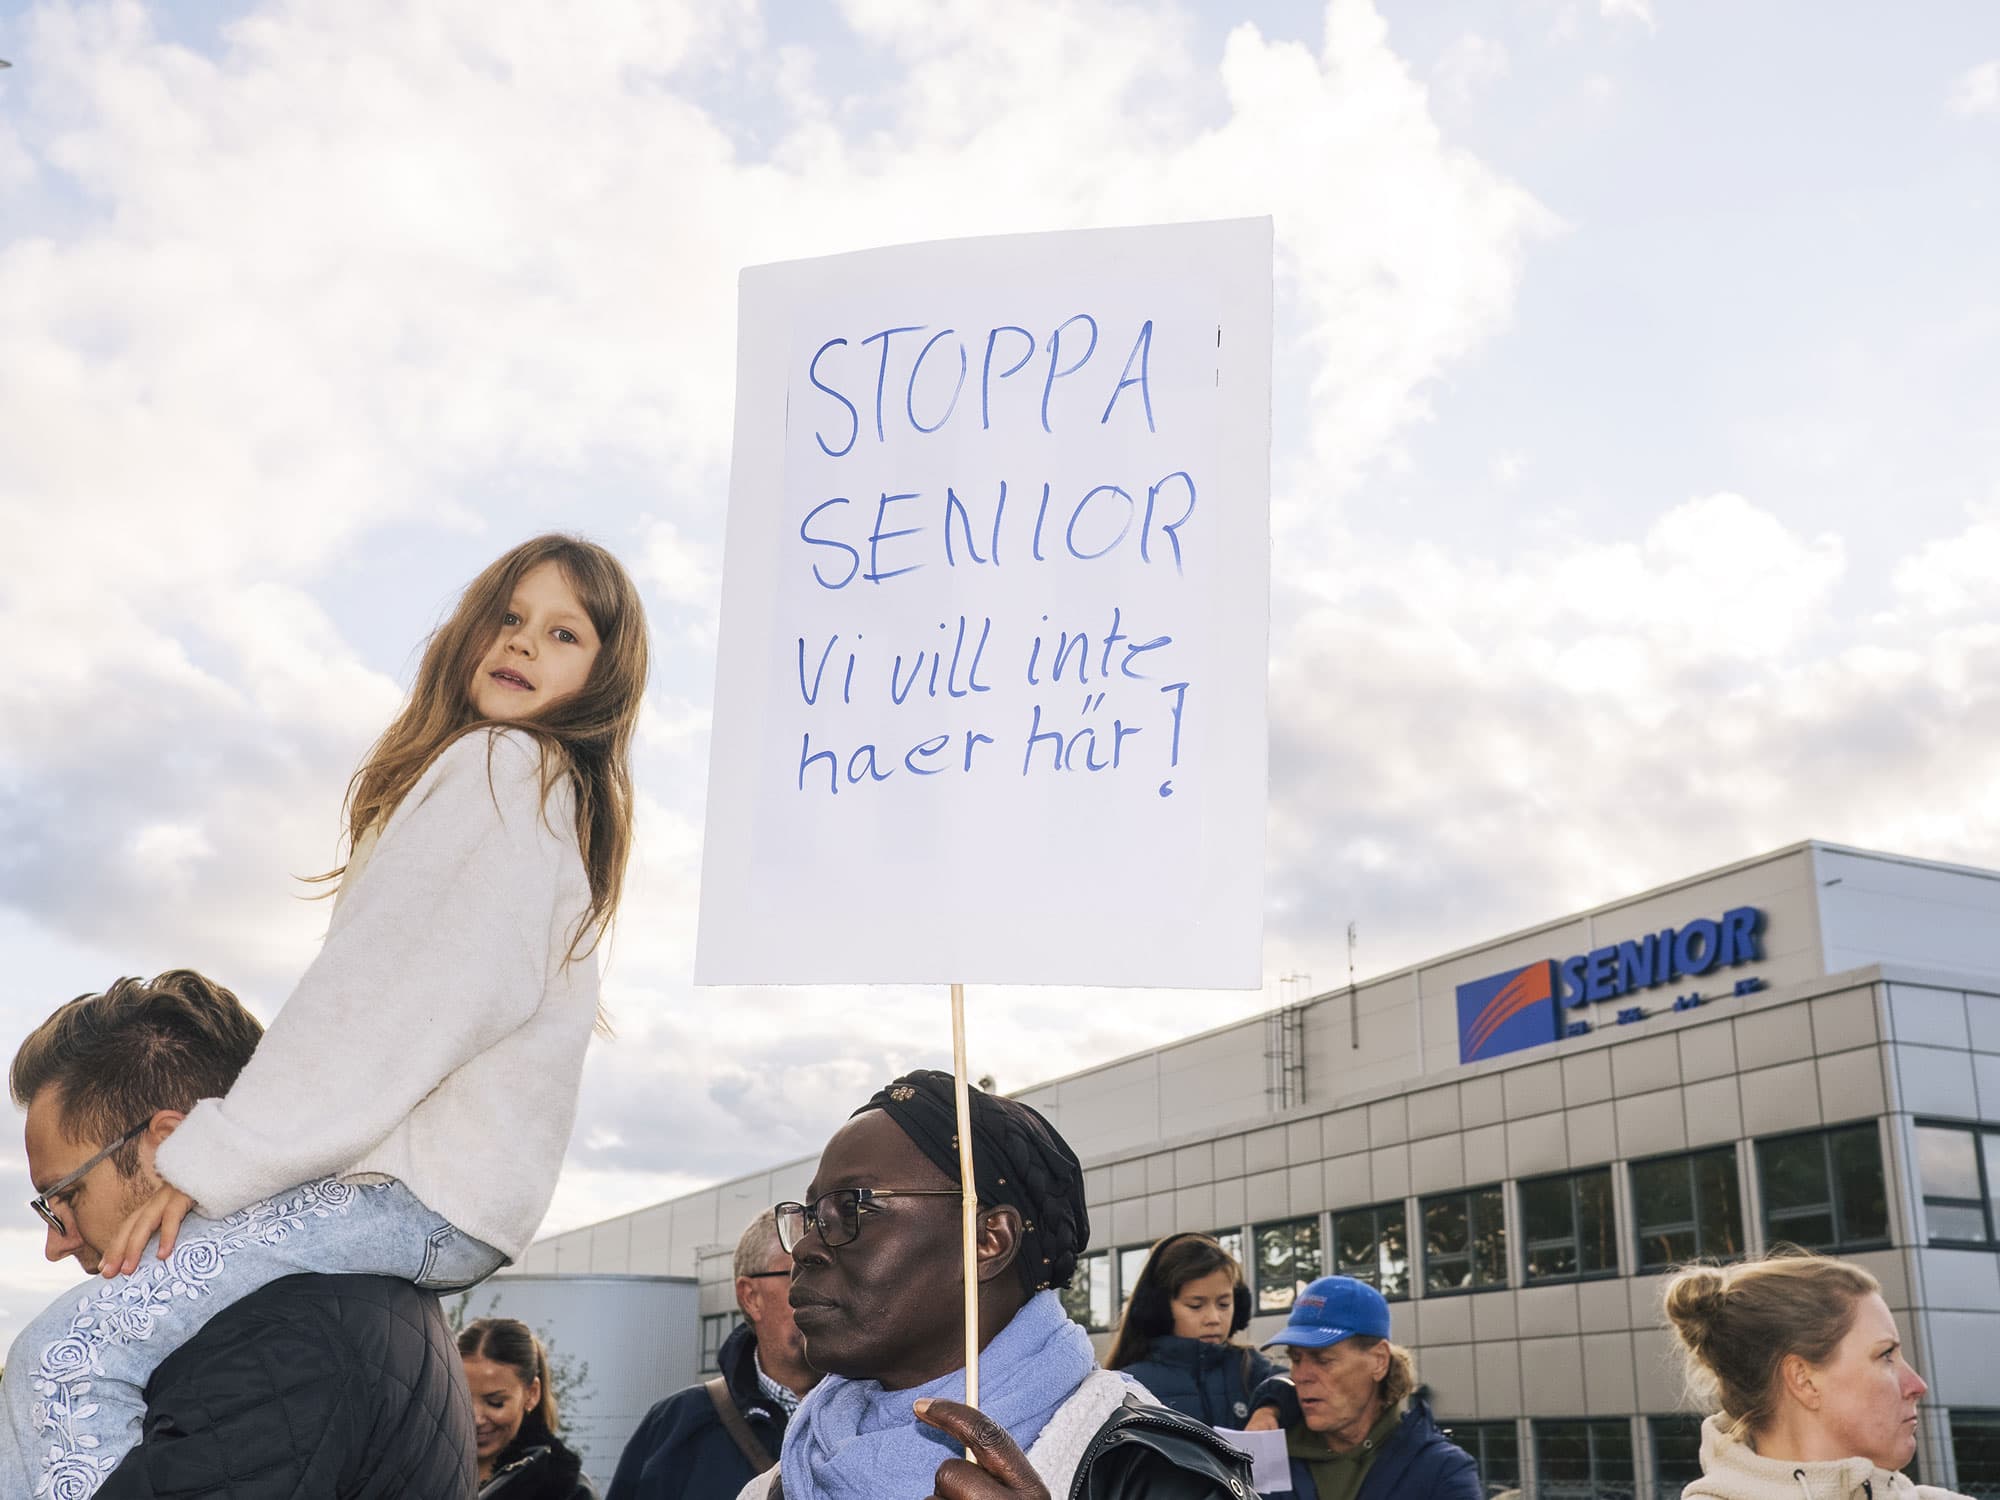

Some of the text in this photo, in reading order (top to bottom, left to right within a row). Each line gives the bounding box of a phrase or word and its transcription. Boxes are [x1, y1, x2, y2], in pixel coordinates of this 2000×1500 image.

[809, 314, 1155, 457] STOPPA
[799, 471, 1196, 589] SENIOR
[798, 607, 1172, 706] Vi vill inte
[1561, 906, 1758, 1010] SENIOR
